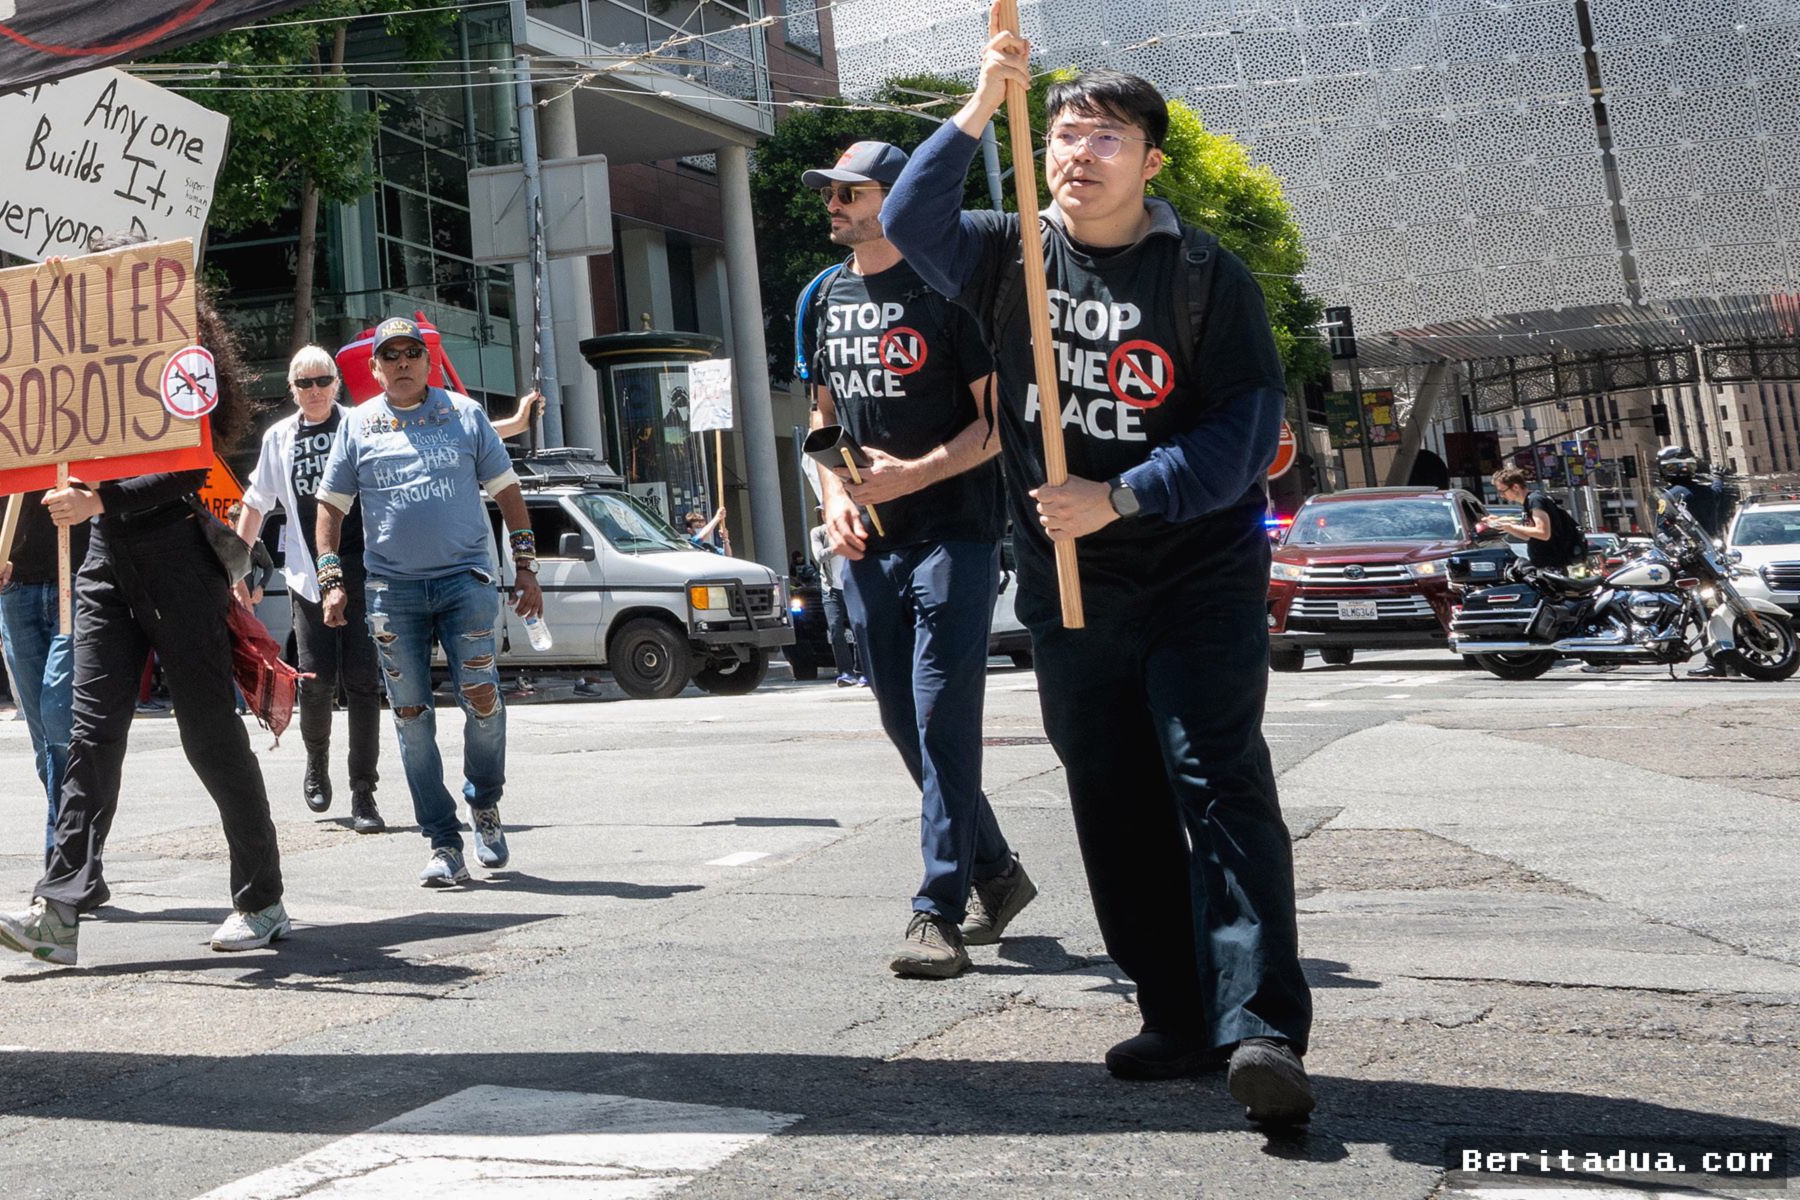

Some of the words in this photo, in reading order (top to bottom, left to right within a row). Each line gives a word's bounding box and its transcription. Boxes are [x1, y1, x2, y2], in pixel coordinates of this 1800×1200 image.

[84, 78, 204, 165] Anyone
[25, 113, 105, 184] Builds
[185, 204, 201, 219] AI
[30, 256, 190, 364] KILLER
[826, 302, 904, 333] STOP
[1046, 289, 1142, 341] STOP
[825, 336, 880, 367] THE
[885, 336, 918, 364] AI
[830, 369, 906, 399] RACE
[1118, 354, 1164, 395] AI
[295, 476, 322, 496] RA
